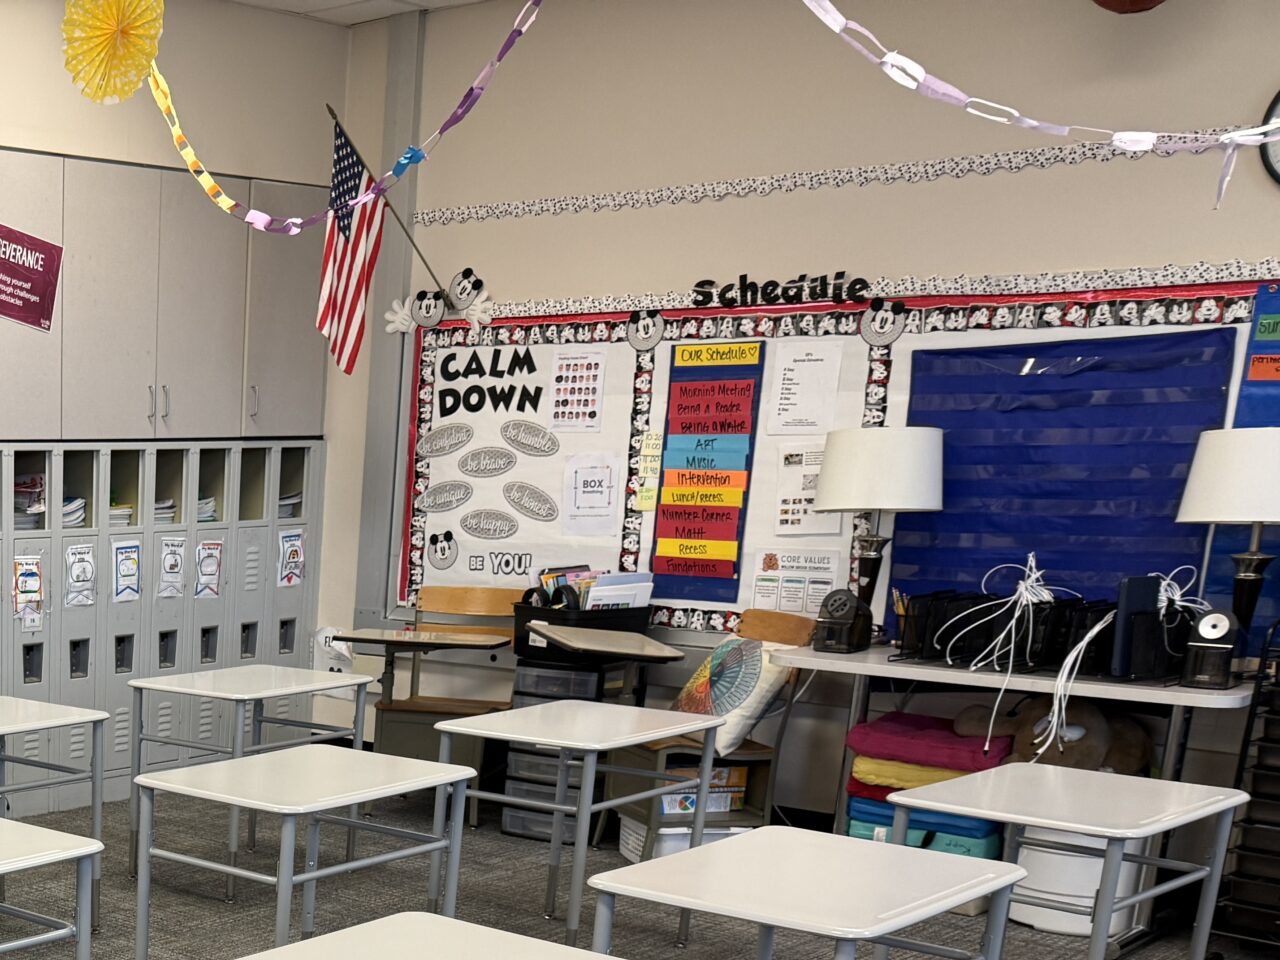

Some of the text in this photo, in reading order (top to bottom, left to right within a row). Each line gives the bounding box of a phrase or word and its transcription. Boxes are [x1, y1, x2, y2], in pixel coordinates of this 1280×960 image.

[11, 278, 32, 289] yourself
[0, 294, 23, 306] obstacles
[14, 289, 40, 302] challenges
[681, 346, 747, 361] OUR Schedule
[441, 346, 537, 381] CALM
[680, 384, 752, 398] Morning Meeting
[439, 384, 543, 418] DOWN
[421, 428, 471, 453] be confident
[504, 423, 556, 451] be humble
[695, 439, 717, 451] ART
[464, 452, 514, 472] be brave
[583, 480, 604, 488] BOX
[678, 472, 730, 487] Intervention
[422, 486, 471, 507] be unique
[508, 484, 553, 516] be honest
[463, 514, 516, 535] be happy
[469, 552, 532, 575] BE YOU!
[667, 559, 717, 573] Fundations
[781, 555, 830, 564] CORE VALUES
